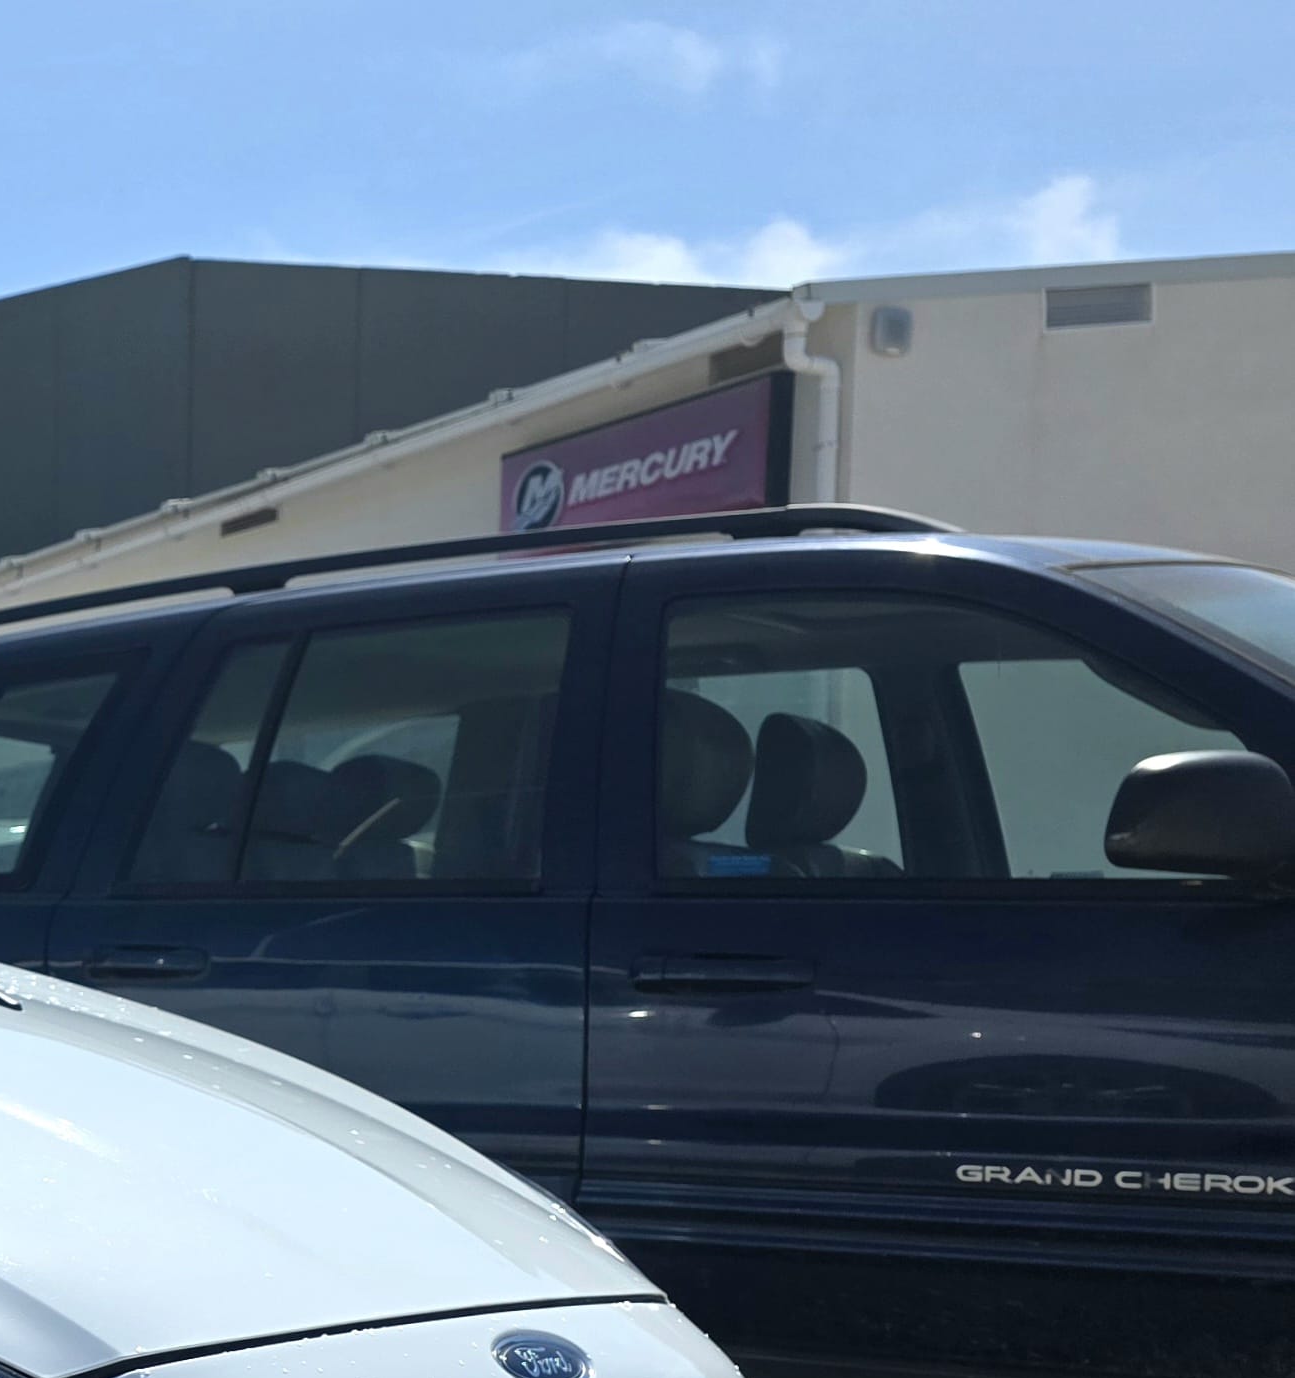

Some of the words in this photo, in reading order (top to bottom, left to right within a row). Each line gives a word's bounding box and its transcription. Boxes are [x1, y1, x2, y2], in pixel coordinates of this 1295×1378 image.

[568, 429, 738, 506] MERCURY
[956, 1164, 1103, 1187] GRAND
[514, 1346, 573, 1378] Ford
